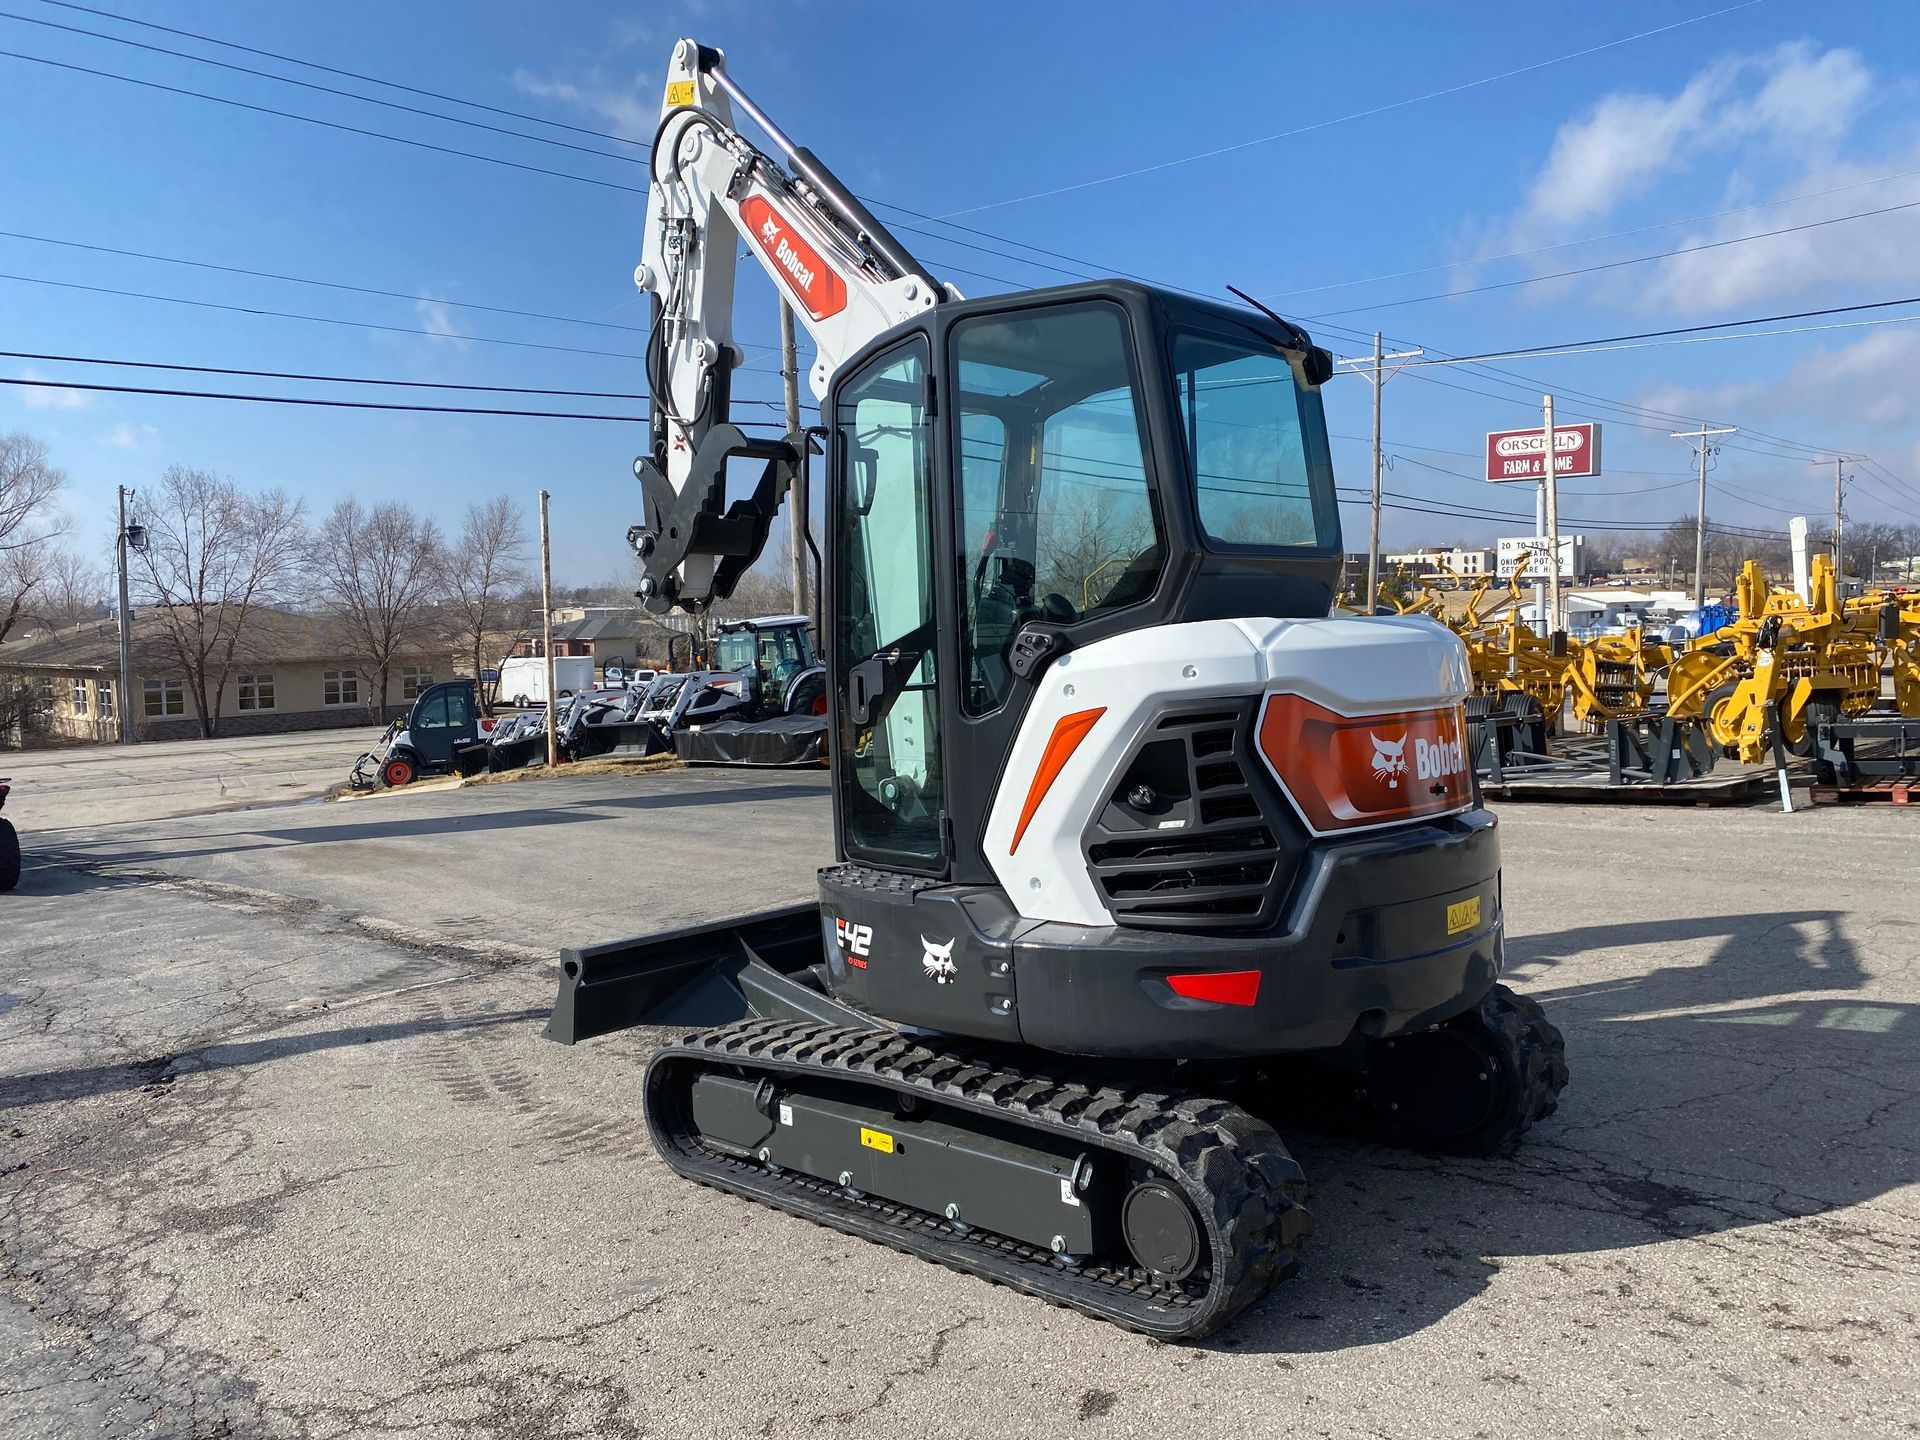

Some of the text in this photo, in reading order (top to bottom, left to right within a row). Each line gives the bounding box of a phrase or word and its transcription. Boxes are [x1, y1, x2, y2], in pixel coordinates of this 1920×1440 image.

[775, 237, 814, 292] Bobcat
[1503, 456, 1574, 475] FARM & OME
[1517, 541, 1526, 549] TO
[1534, 557, 1564, 565] POTO
[835, 917, 873, 957] E42
